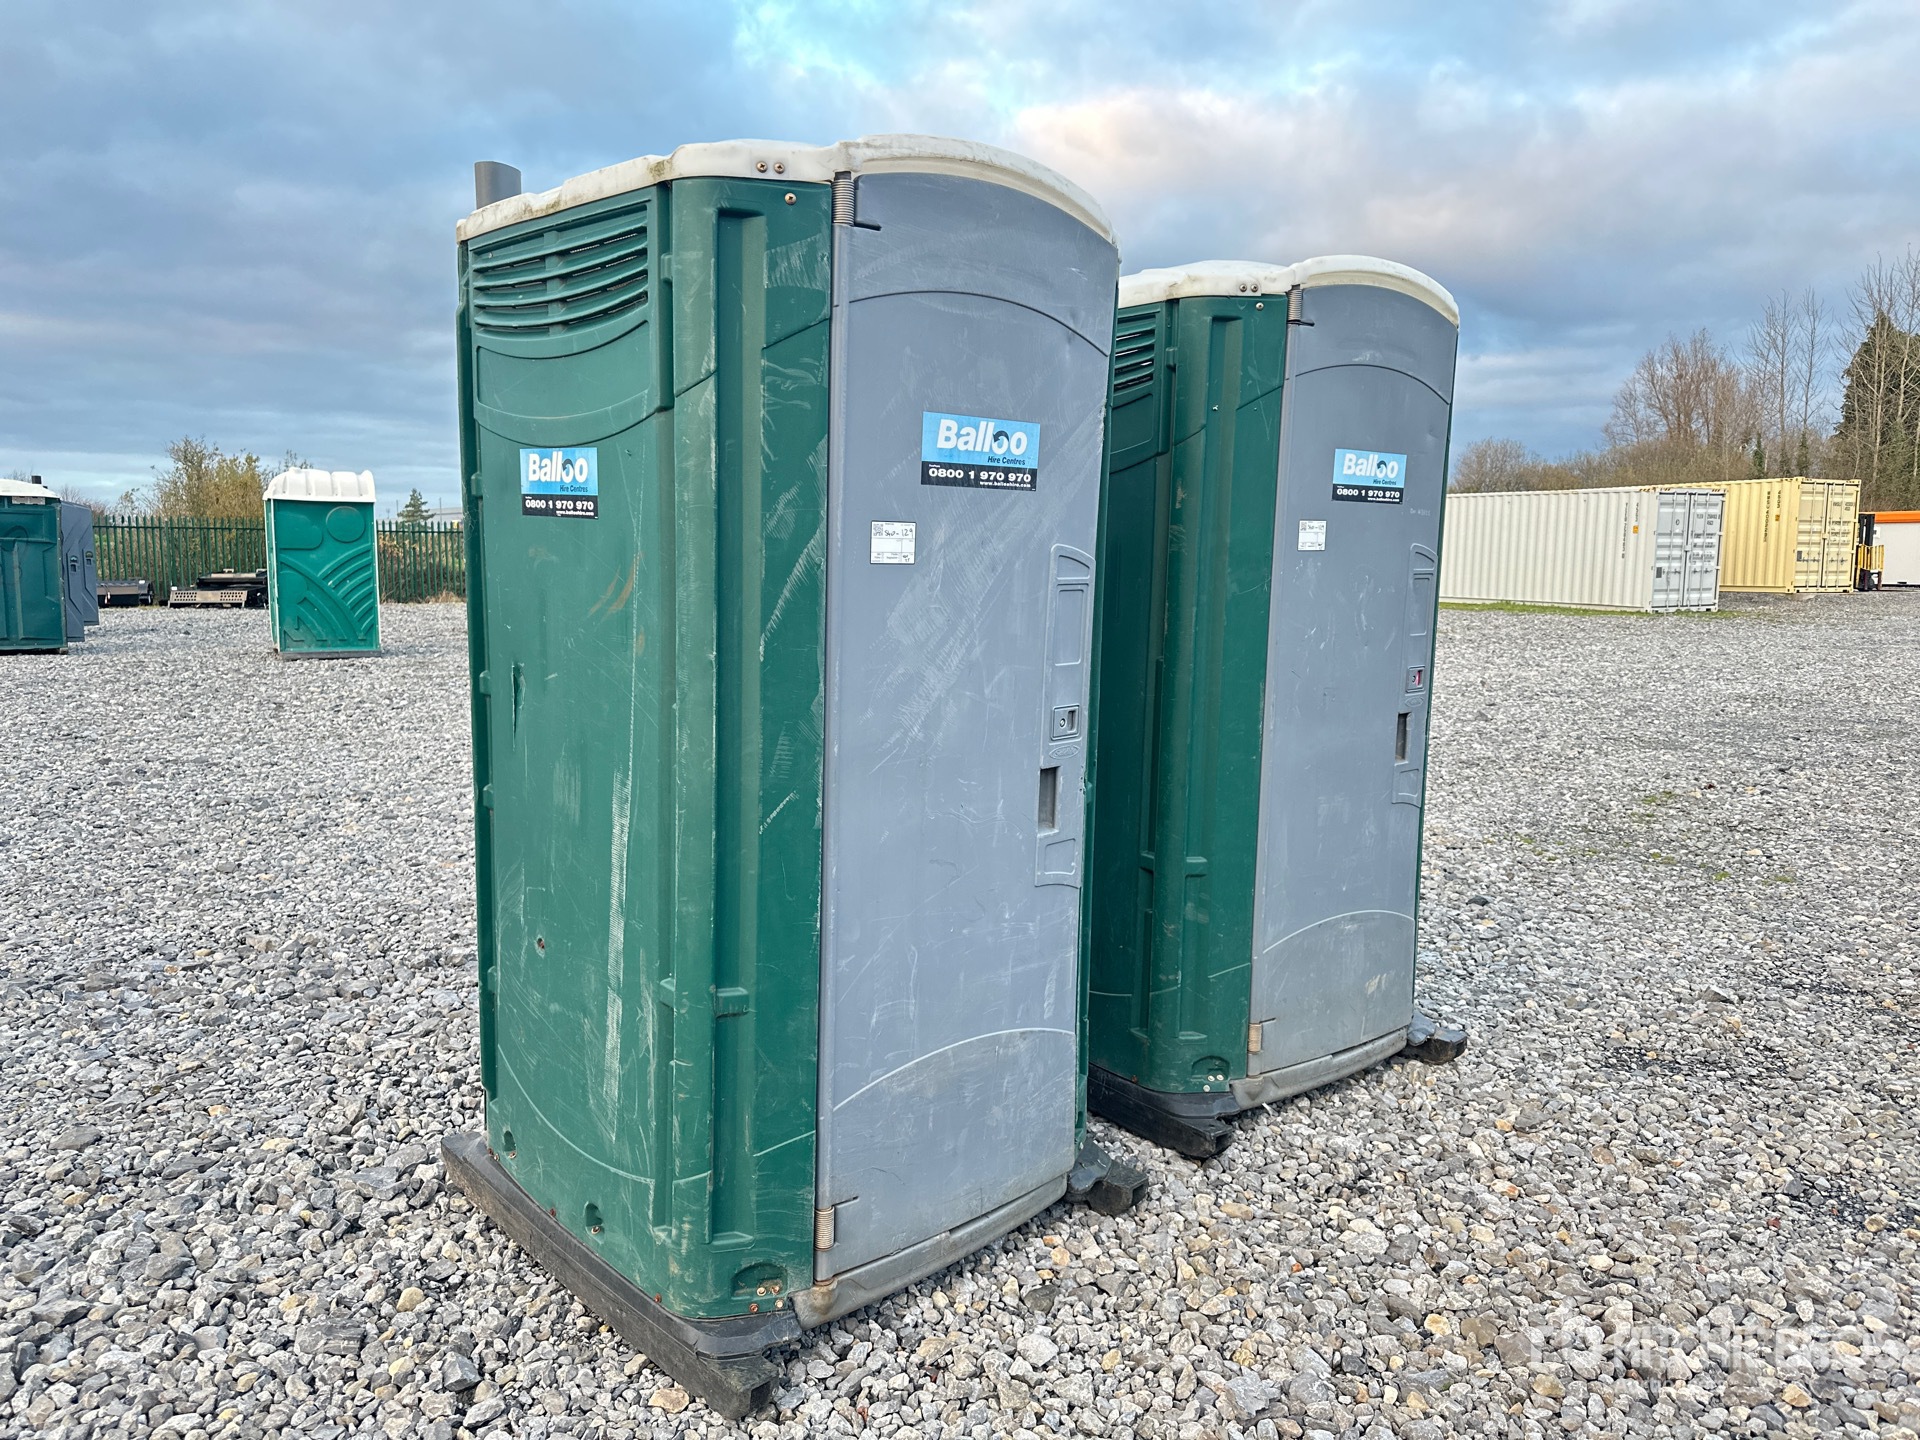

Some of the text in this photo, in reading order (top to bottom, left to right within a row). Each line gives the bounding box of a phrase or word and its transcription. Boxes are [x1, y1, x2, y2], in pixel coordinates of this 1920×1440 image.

[937, 418, 1028, 456] Balloo
[528, 450, 588, 483] Balloo
[987, 456, 1026, 466] Hire Centres
[1342, 453, 1399, 479] Balloo
[928, 468, 1032, 482] 0800 1 970 970
[560, 485, 589, 493] Hire Centres
[1336, 488, 1359, 496] 0800
[1361, 489, 1366, 497] 1
[525, 499, 594, 510] 0800 1 970 970
